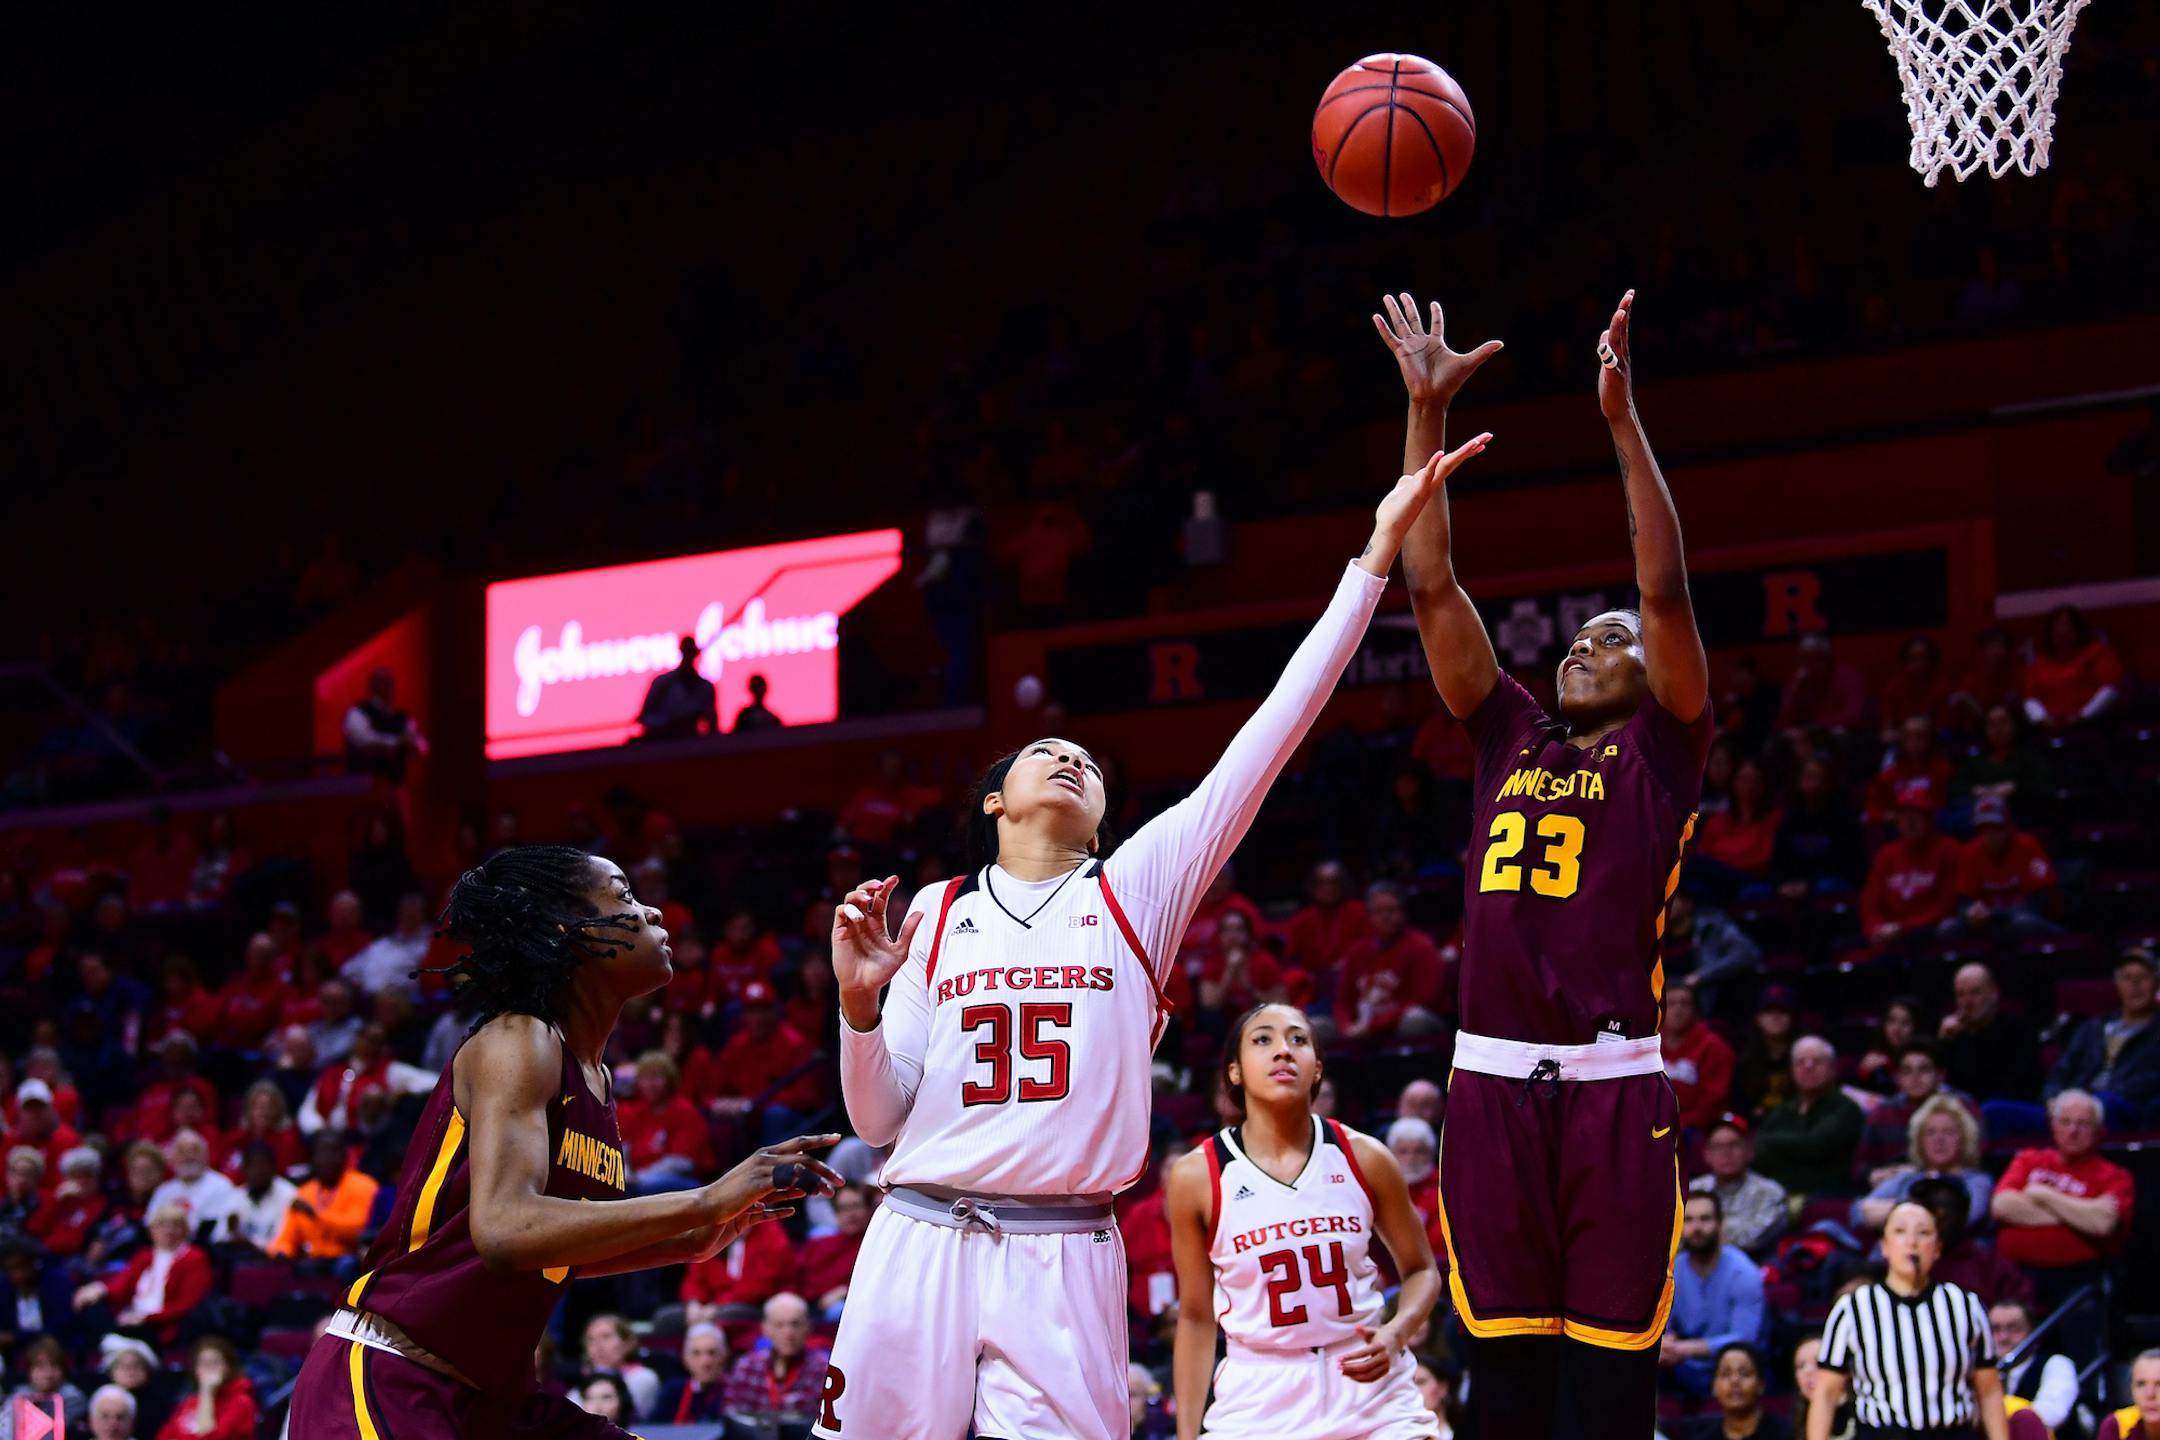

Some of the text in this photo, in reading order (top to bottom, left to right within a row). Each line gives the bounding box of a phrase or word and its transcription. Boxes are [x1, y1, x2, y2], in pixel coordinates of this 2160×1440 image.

[1761, 572, 1828, 637] R
[1151, 643, 1204, 702] R
[1479, 811, 1585, 898] 23
[937, 965, 1114, 1005] RUTGERS
[962, 1002, 1072, 1107] 35
[1608, 1020, 1620, 1031] M
[557, 1127, 625, 1192] MINNESOTA
[1233, 1216, 1362, 1254] RUTGERS
[1259, 1241, 1352, 1328] 24
